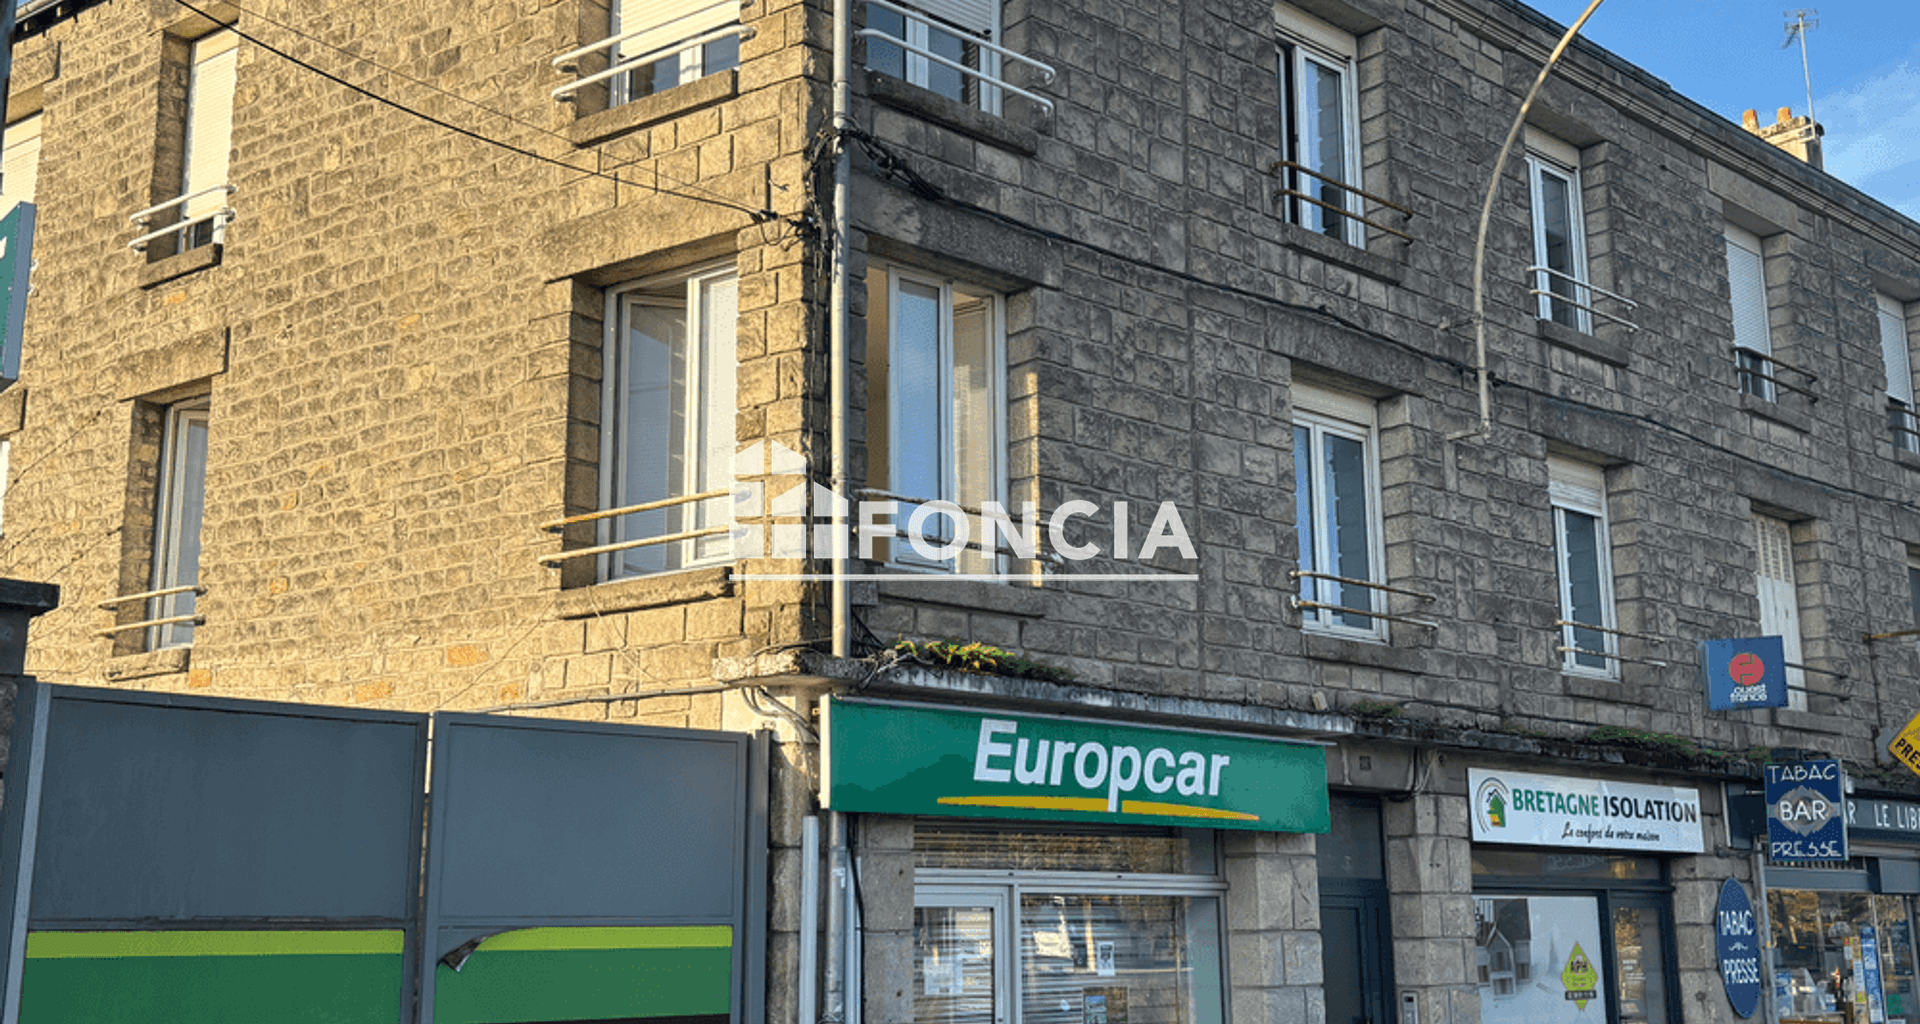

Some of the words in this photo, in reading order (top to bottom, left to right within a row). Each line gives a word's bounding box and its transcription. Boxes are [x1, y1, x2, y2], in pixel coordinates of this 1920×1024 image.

[973, 718, 1230, 813] Europcar
[1766, 763, 1837, 784] TABAC
[1512, 788, 1601, 817] BRETAGNE
[1603, 795, 1698, 823] ISOLATION
[1780, 799, 1826, 821] BAR
[1874, 803, 1890, 828] LE
[1771, 840, 1842, 858] PRESSE
[1720, 909, 1753, 936] TABAC
[1723, 957, 1760, 985] PRESSE
